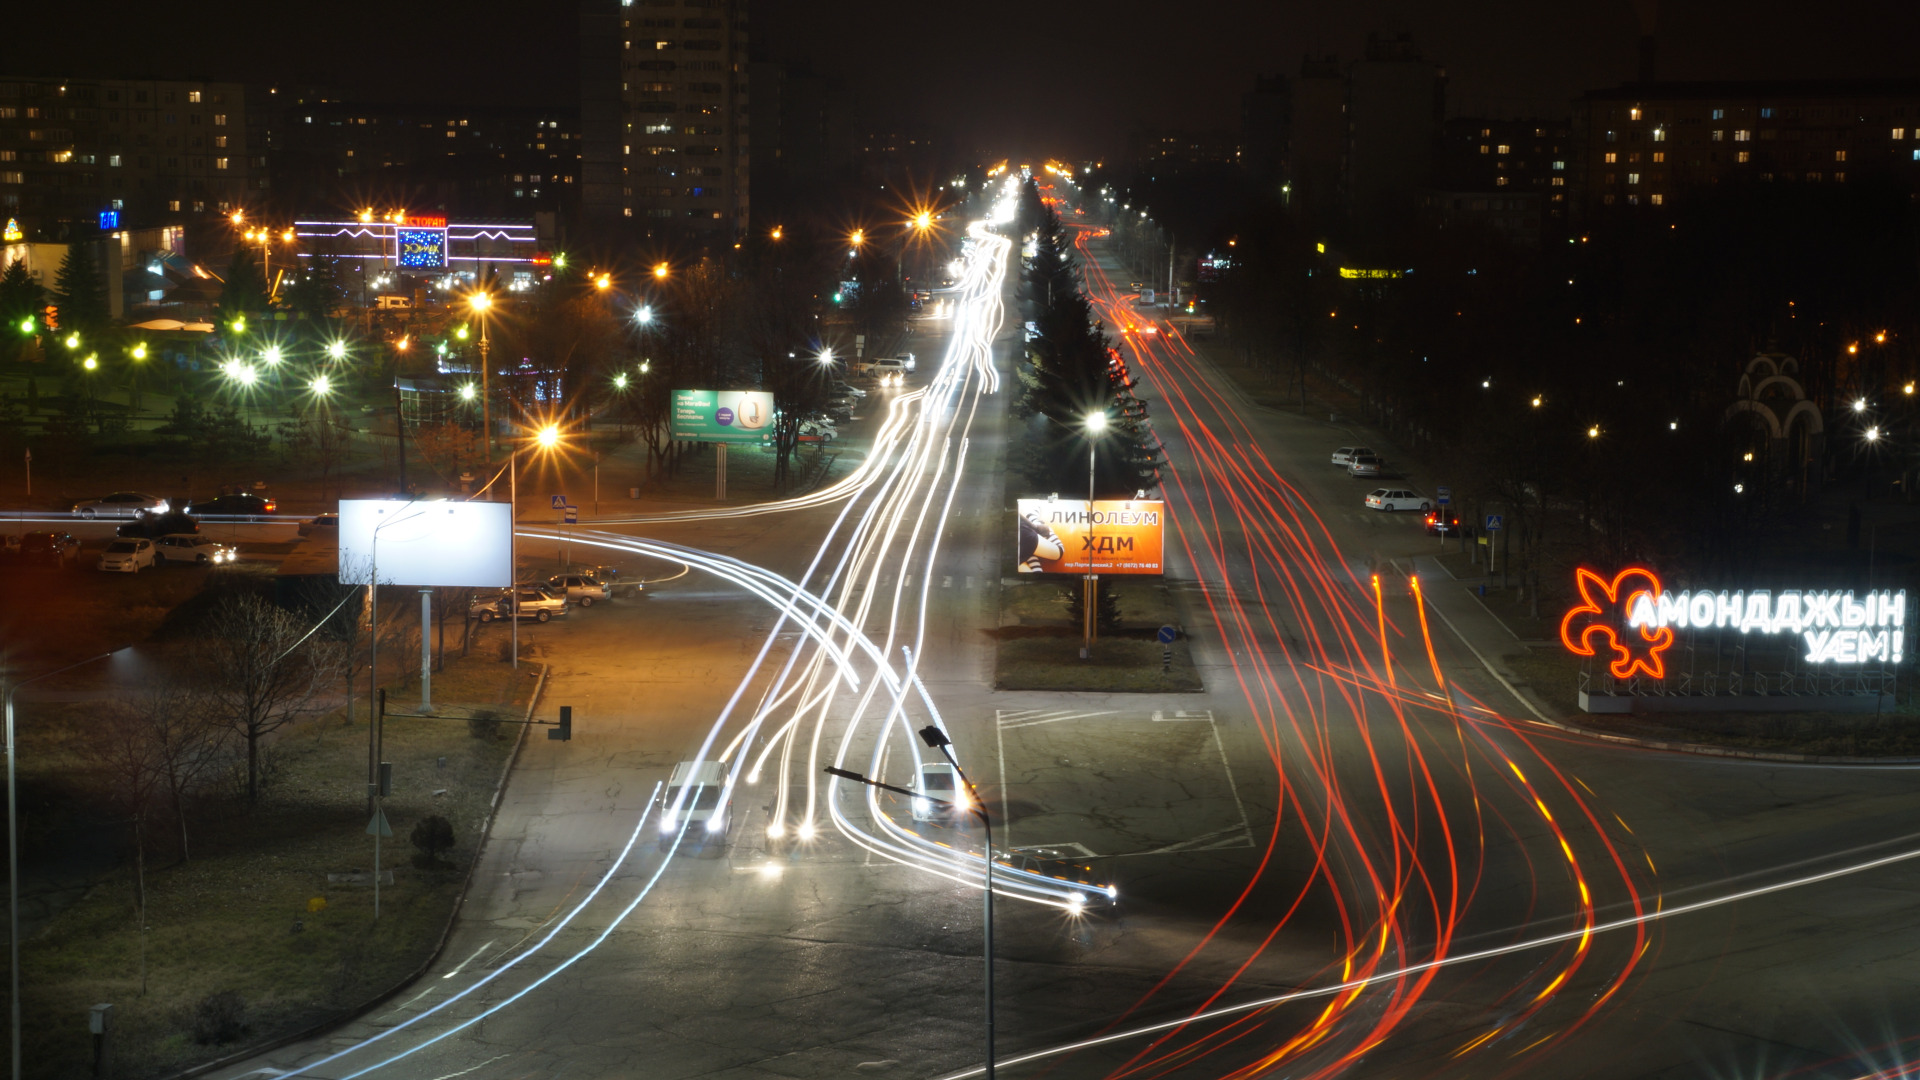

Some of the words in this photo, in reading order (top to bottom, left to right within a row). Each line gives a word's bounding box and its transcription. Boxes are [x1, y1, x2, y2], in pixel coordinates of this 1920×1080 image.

[397, 216, 447, 228] ЕСТОРАН
[1050, 511, 1158, 525] ЛИНОЛЕУМ
[1082, 535, 1134, 554] ХДМ
[1630, 593, 1906, 634] АМОНДДЖЫН
